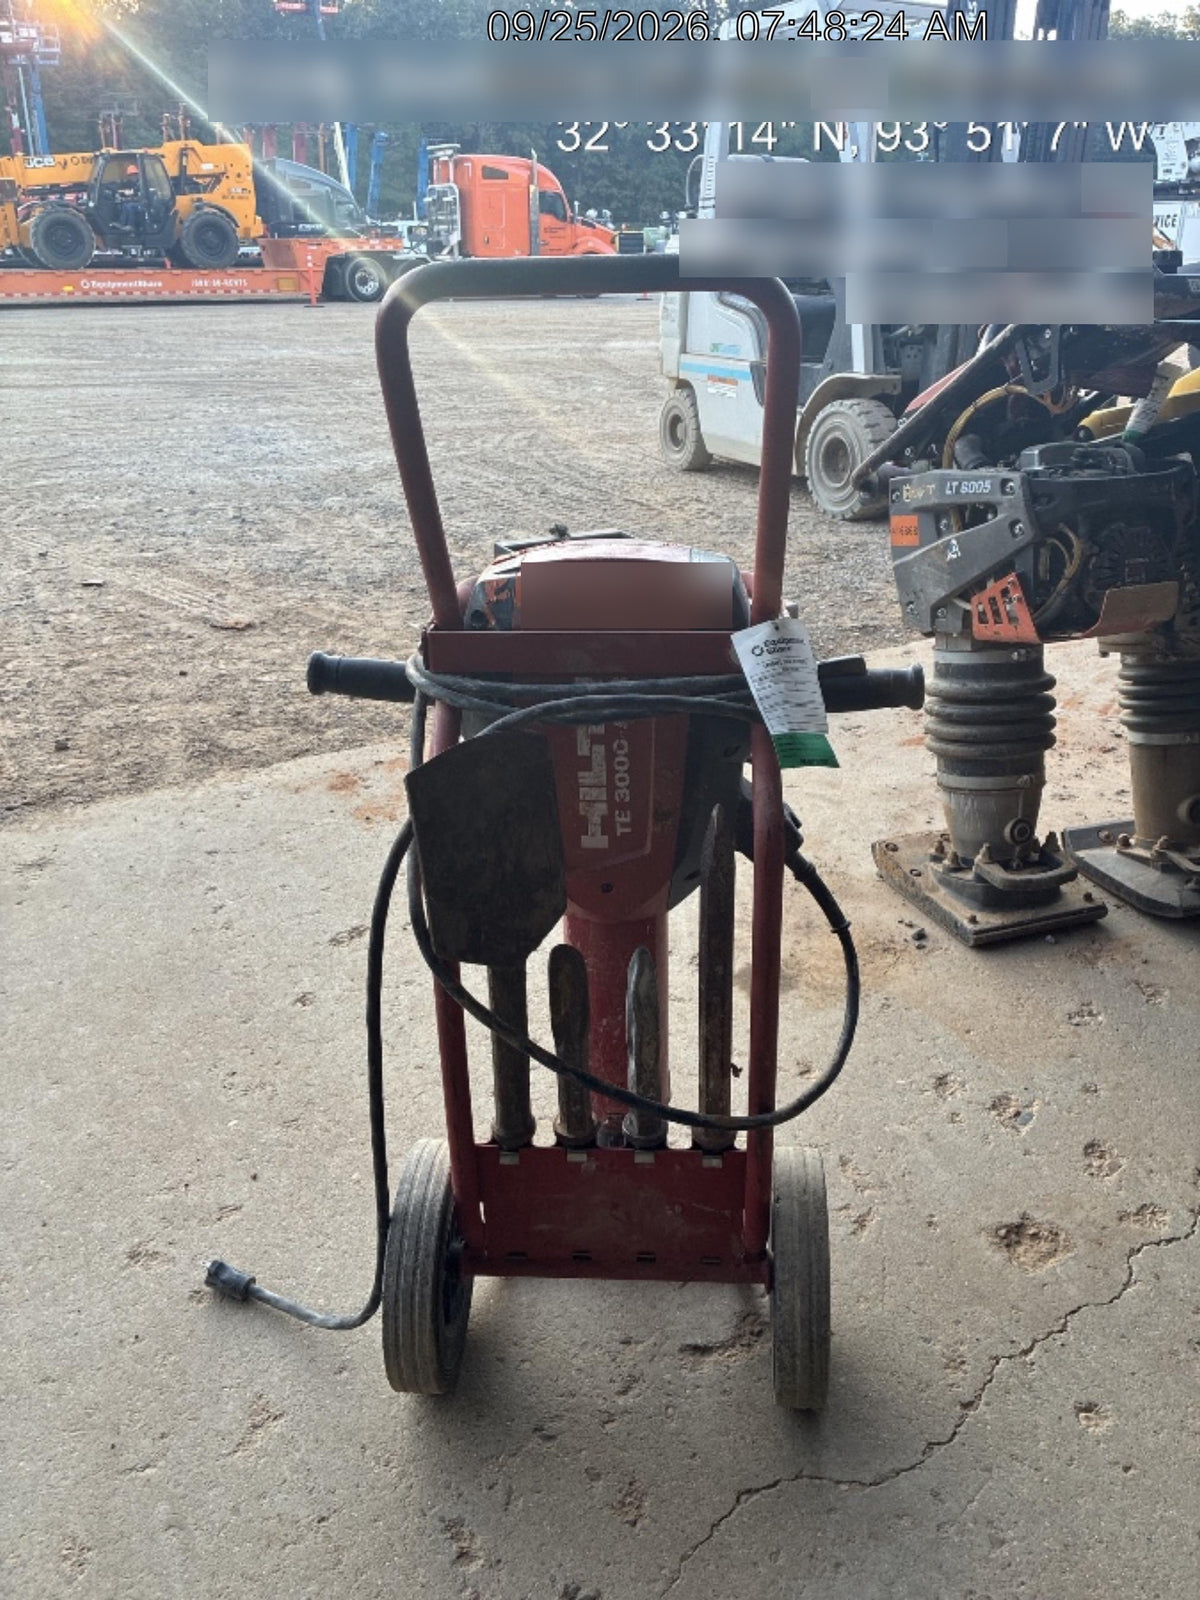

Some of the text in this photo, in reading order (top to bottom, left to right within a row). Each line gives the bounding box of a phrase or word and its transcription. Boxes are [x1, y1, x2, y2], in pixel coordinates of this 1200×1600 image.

[24, 156, 55, 168] JCB
[945, 482, 959, 495] LT
[576, 678, 609, 849] HILT
[615, 809, 632, 837] TE
